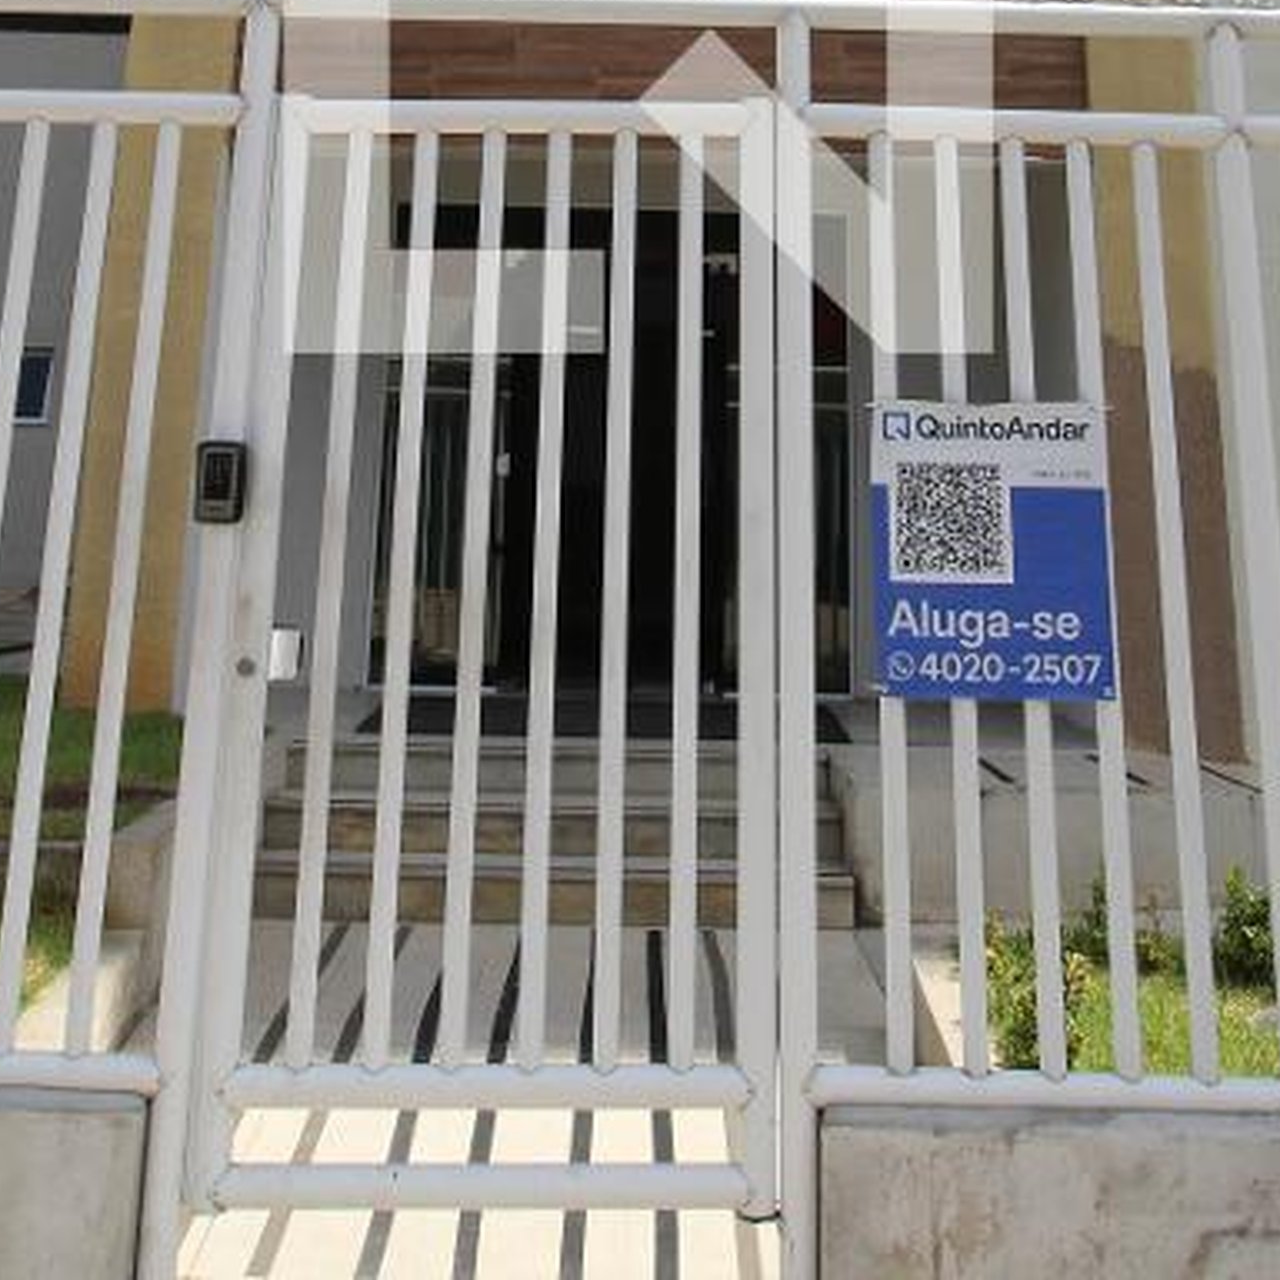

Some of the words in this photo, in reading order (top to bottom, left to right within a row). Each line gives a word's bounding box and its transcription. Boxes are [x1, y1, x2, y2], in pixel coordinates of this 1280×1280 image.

[915, 414, 1090, 441] QuintoAndar
[887, 598, 1081, 648] Aluga-se
[918, 653, 1102, 684] 4020-2507
